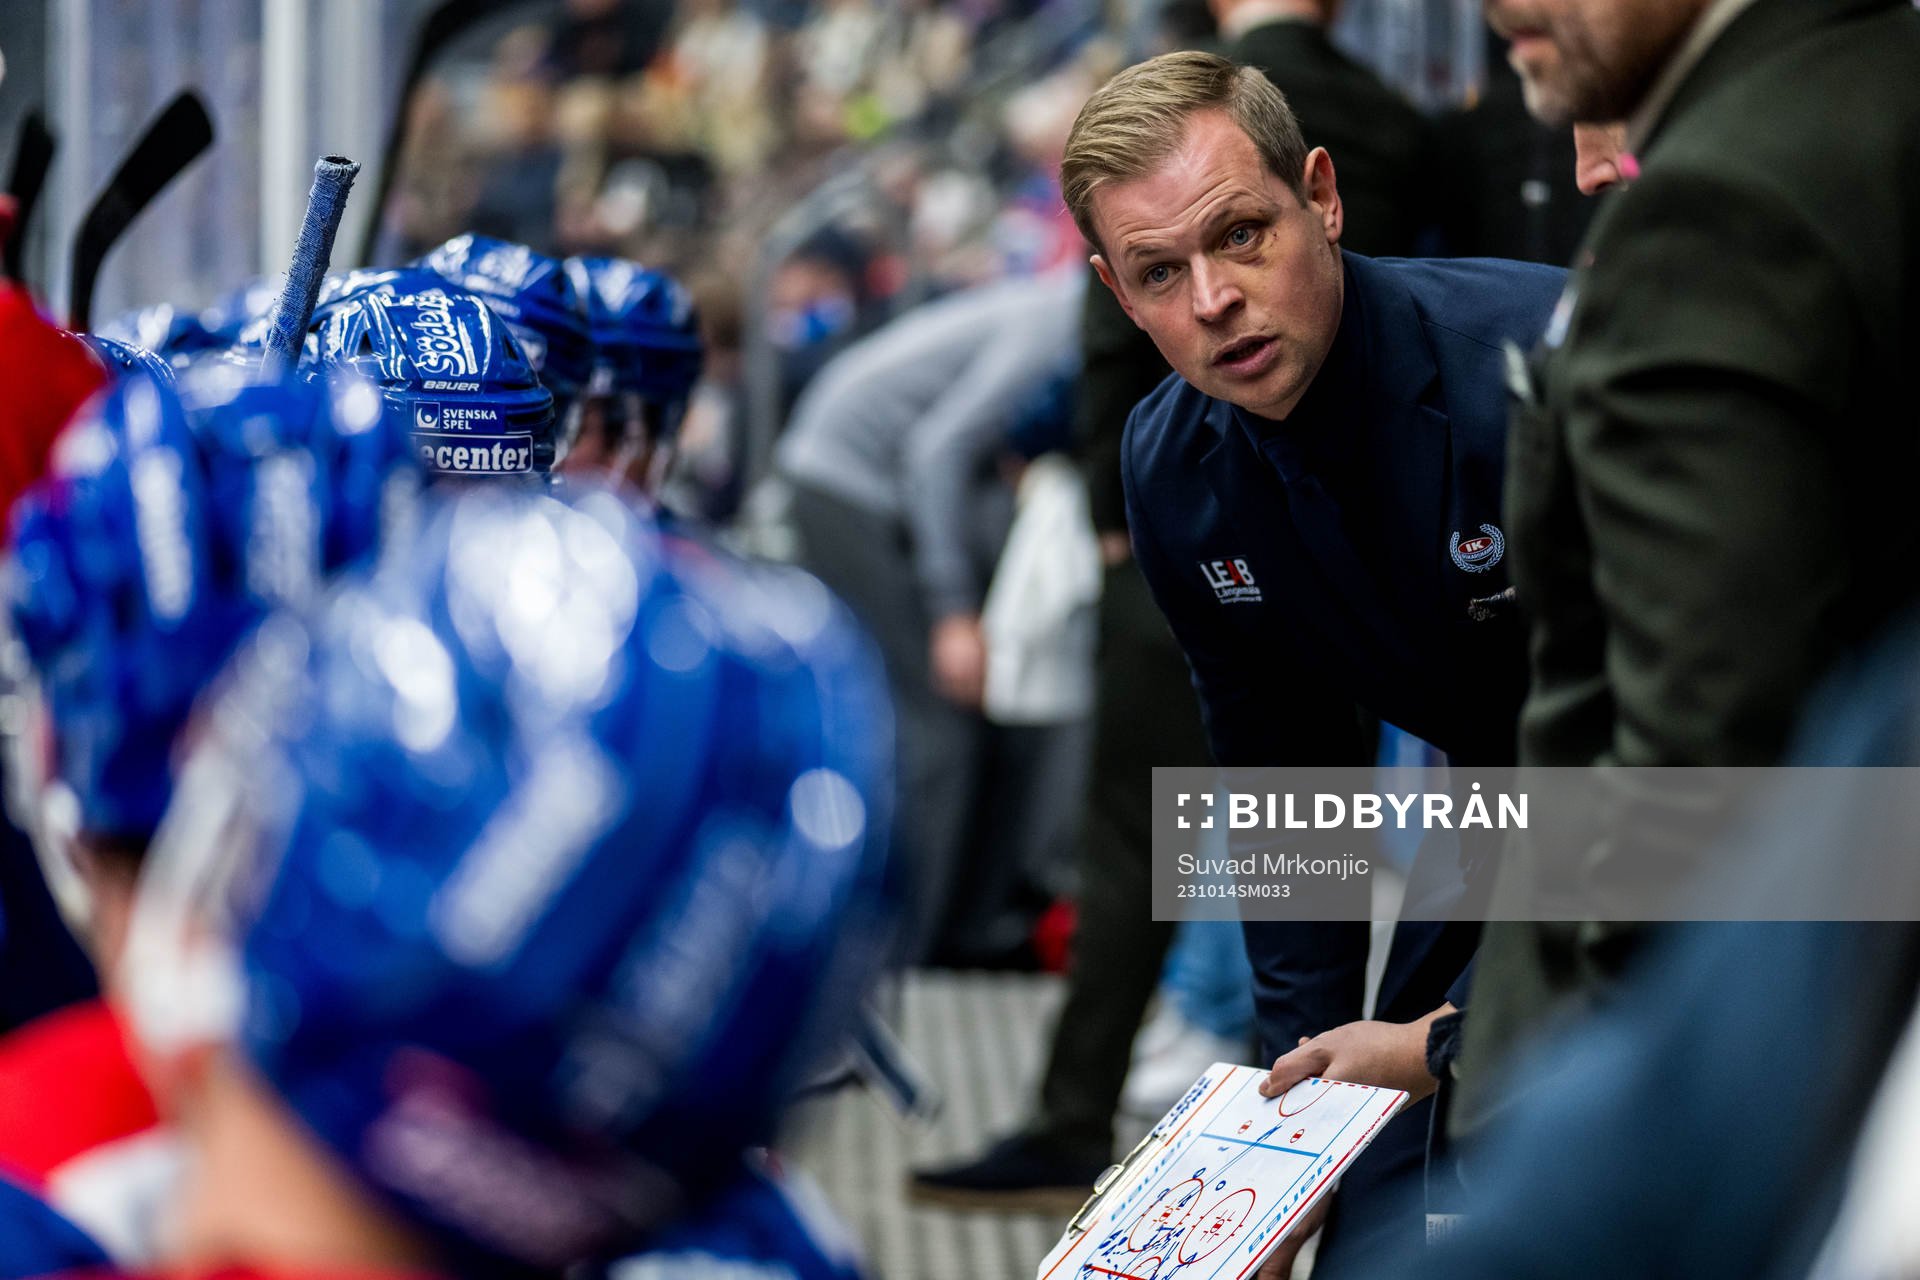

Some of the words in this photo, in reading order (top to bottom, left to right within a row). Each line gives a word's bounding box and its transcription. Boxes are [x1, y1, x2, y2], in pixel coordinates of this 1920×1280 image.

[443, 408, 497, 420] SVENSKA
[443, 420, 472, 430] SPEL
[1465, 540, 1485, 553] IK
[1200, 559, 1254, 588] LEAB
